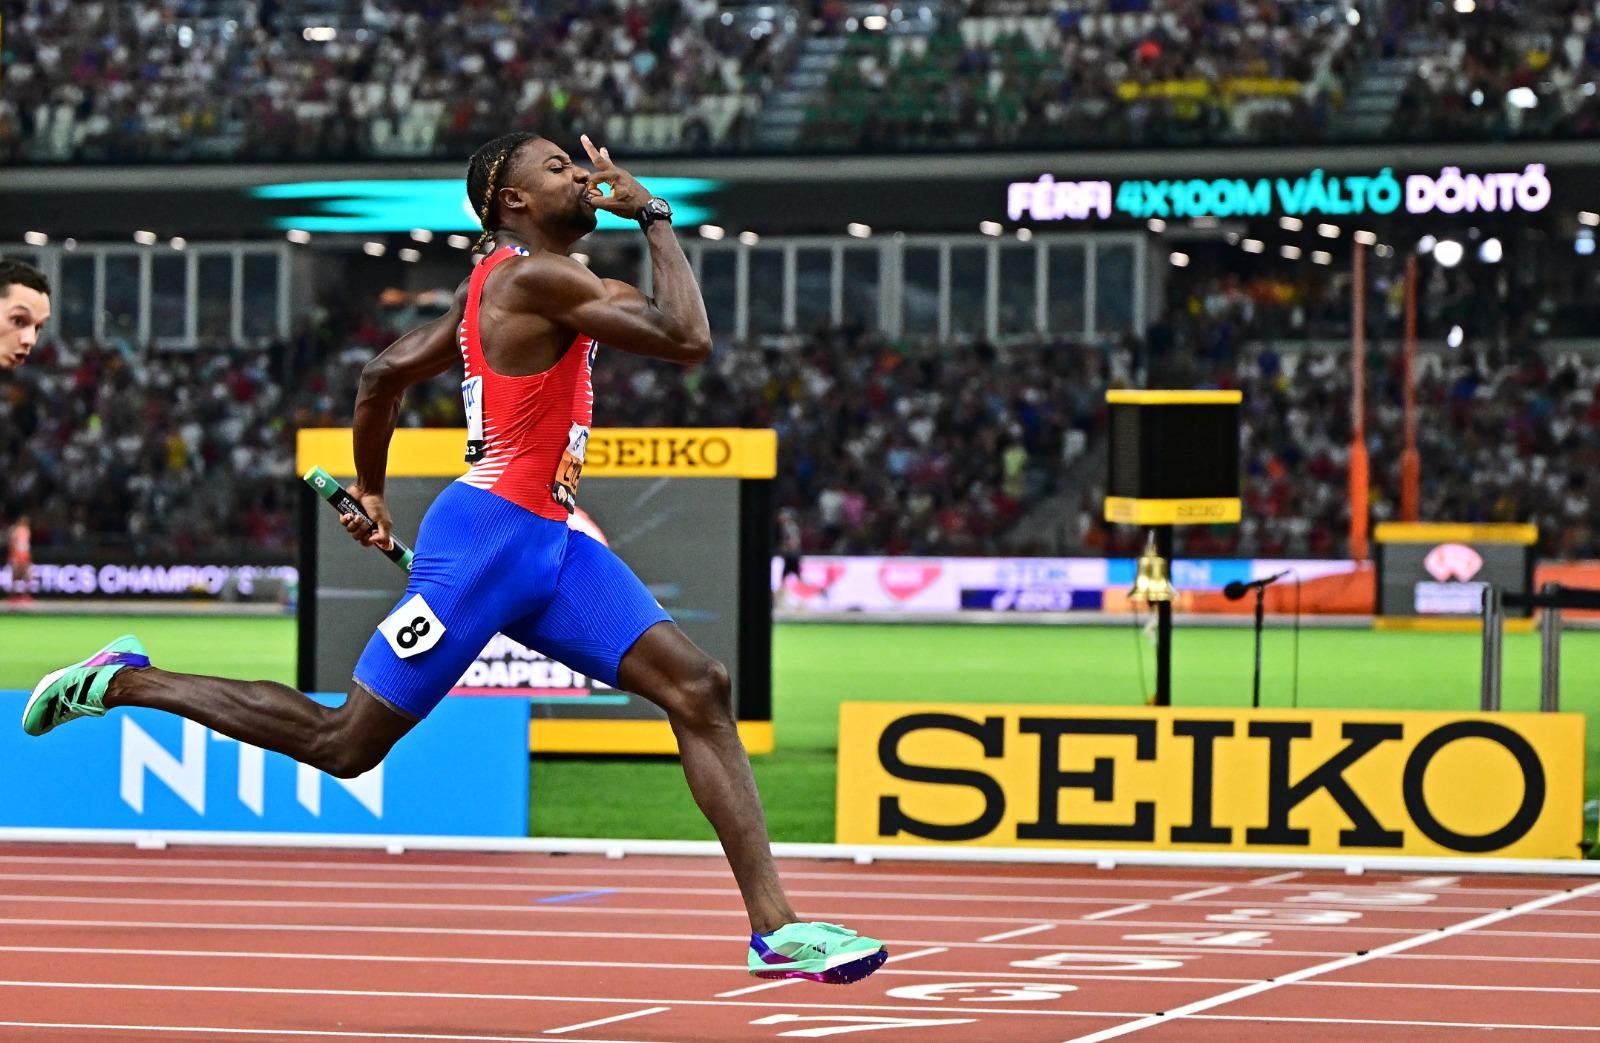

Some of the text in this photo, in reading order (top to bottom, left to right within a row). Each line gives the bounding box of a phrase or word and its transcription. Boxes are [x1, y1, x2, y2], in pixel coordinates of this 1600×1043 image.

[1008, 173, 1111, 220] FÉRFI
[1116, 178, 1271, 217] 4X100M
[1276, 168, 1400, 216] VÁLTÓ
[585, 437, 731, 467] SEIKO
[396, 615, 431, 650] 8
[877, 712, 1547, 854] SEIKO
